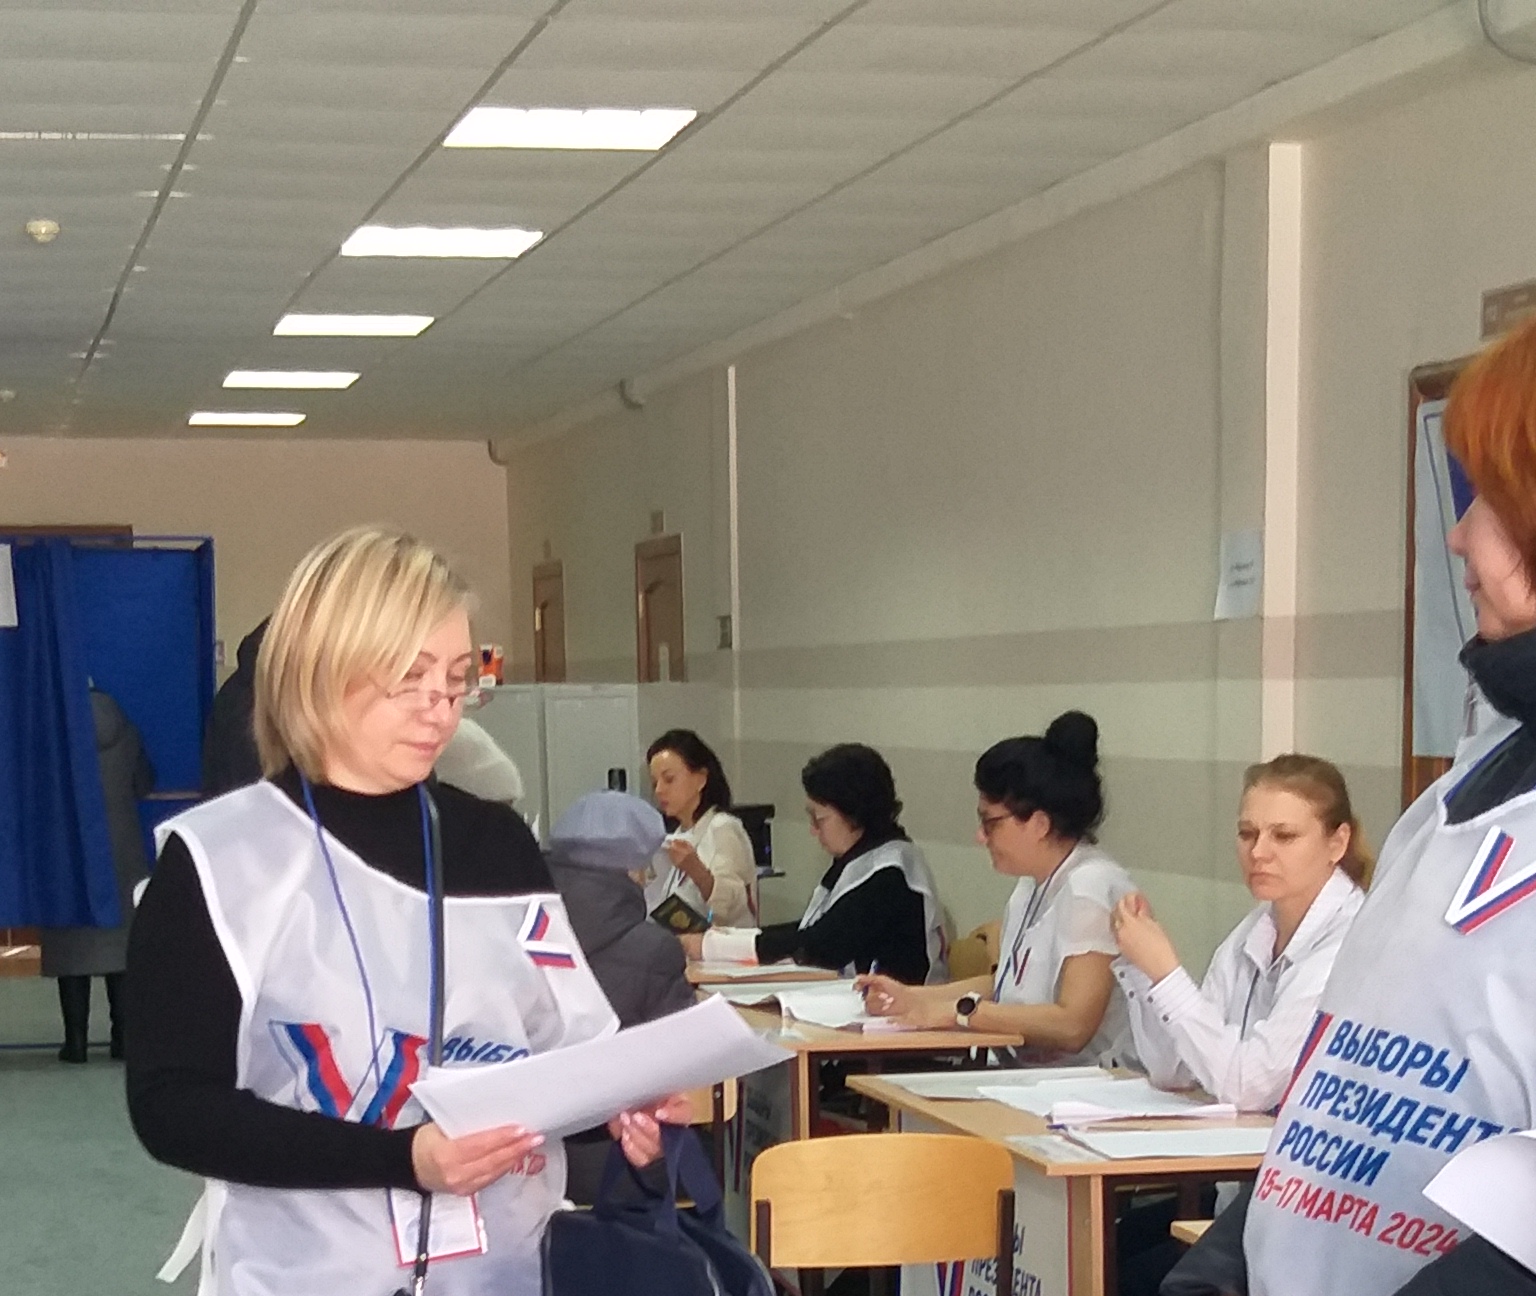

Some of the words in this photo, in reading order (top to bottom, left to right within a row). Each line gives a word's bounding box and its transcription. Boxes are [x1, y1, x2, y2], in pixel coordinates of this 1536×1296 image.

[1325, 1019, 1471, 1094] ВЫБОРЫ
[1300, 1069, 1522, 1154] ПРЕЗИДЕНТ
[1275, 1119, 1391, 1187] РОССИИ
[1293, 1183, 1381, 1237] МАРТА
[1377, 1211, 1460, 1257] 2024
